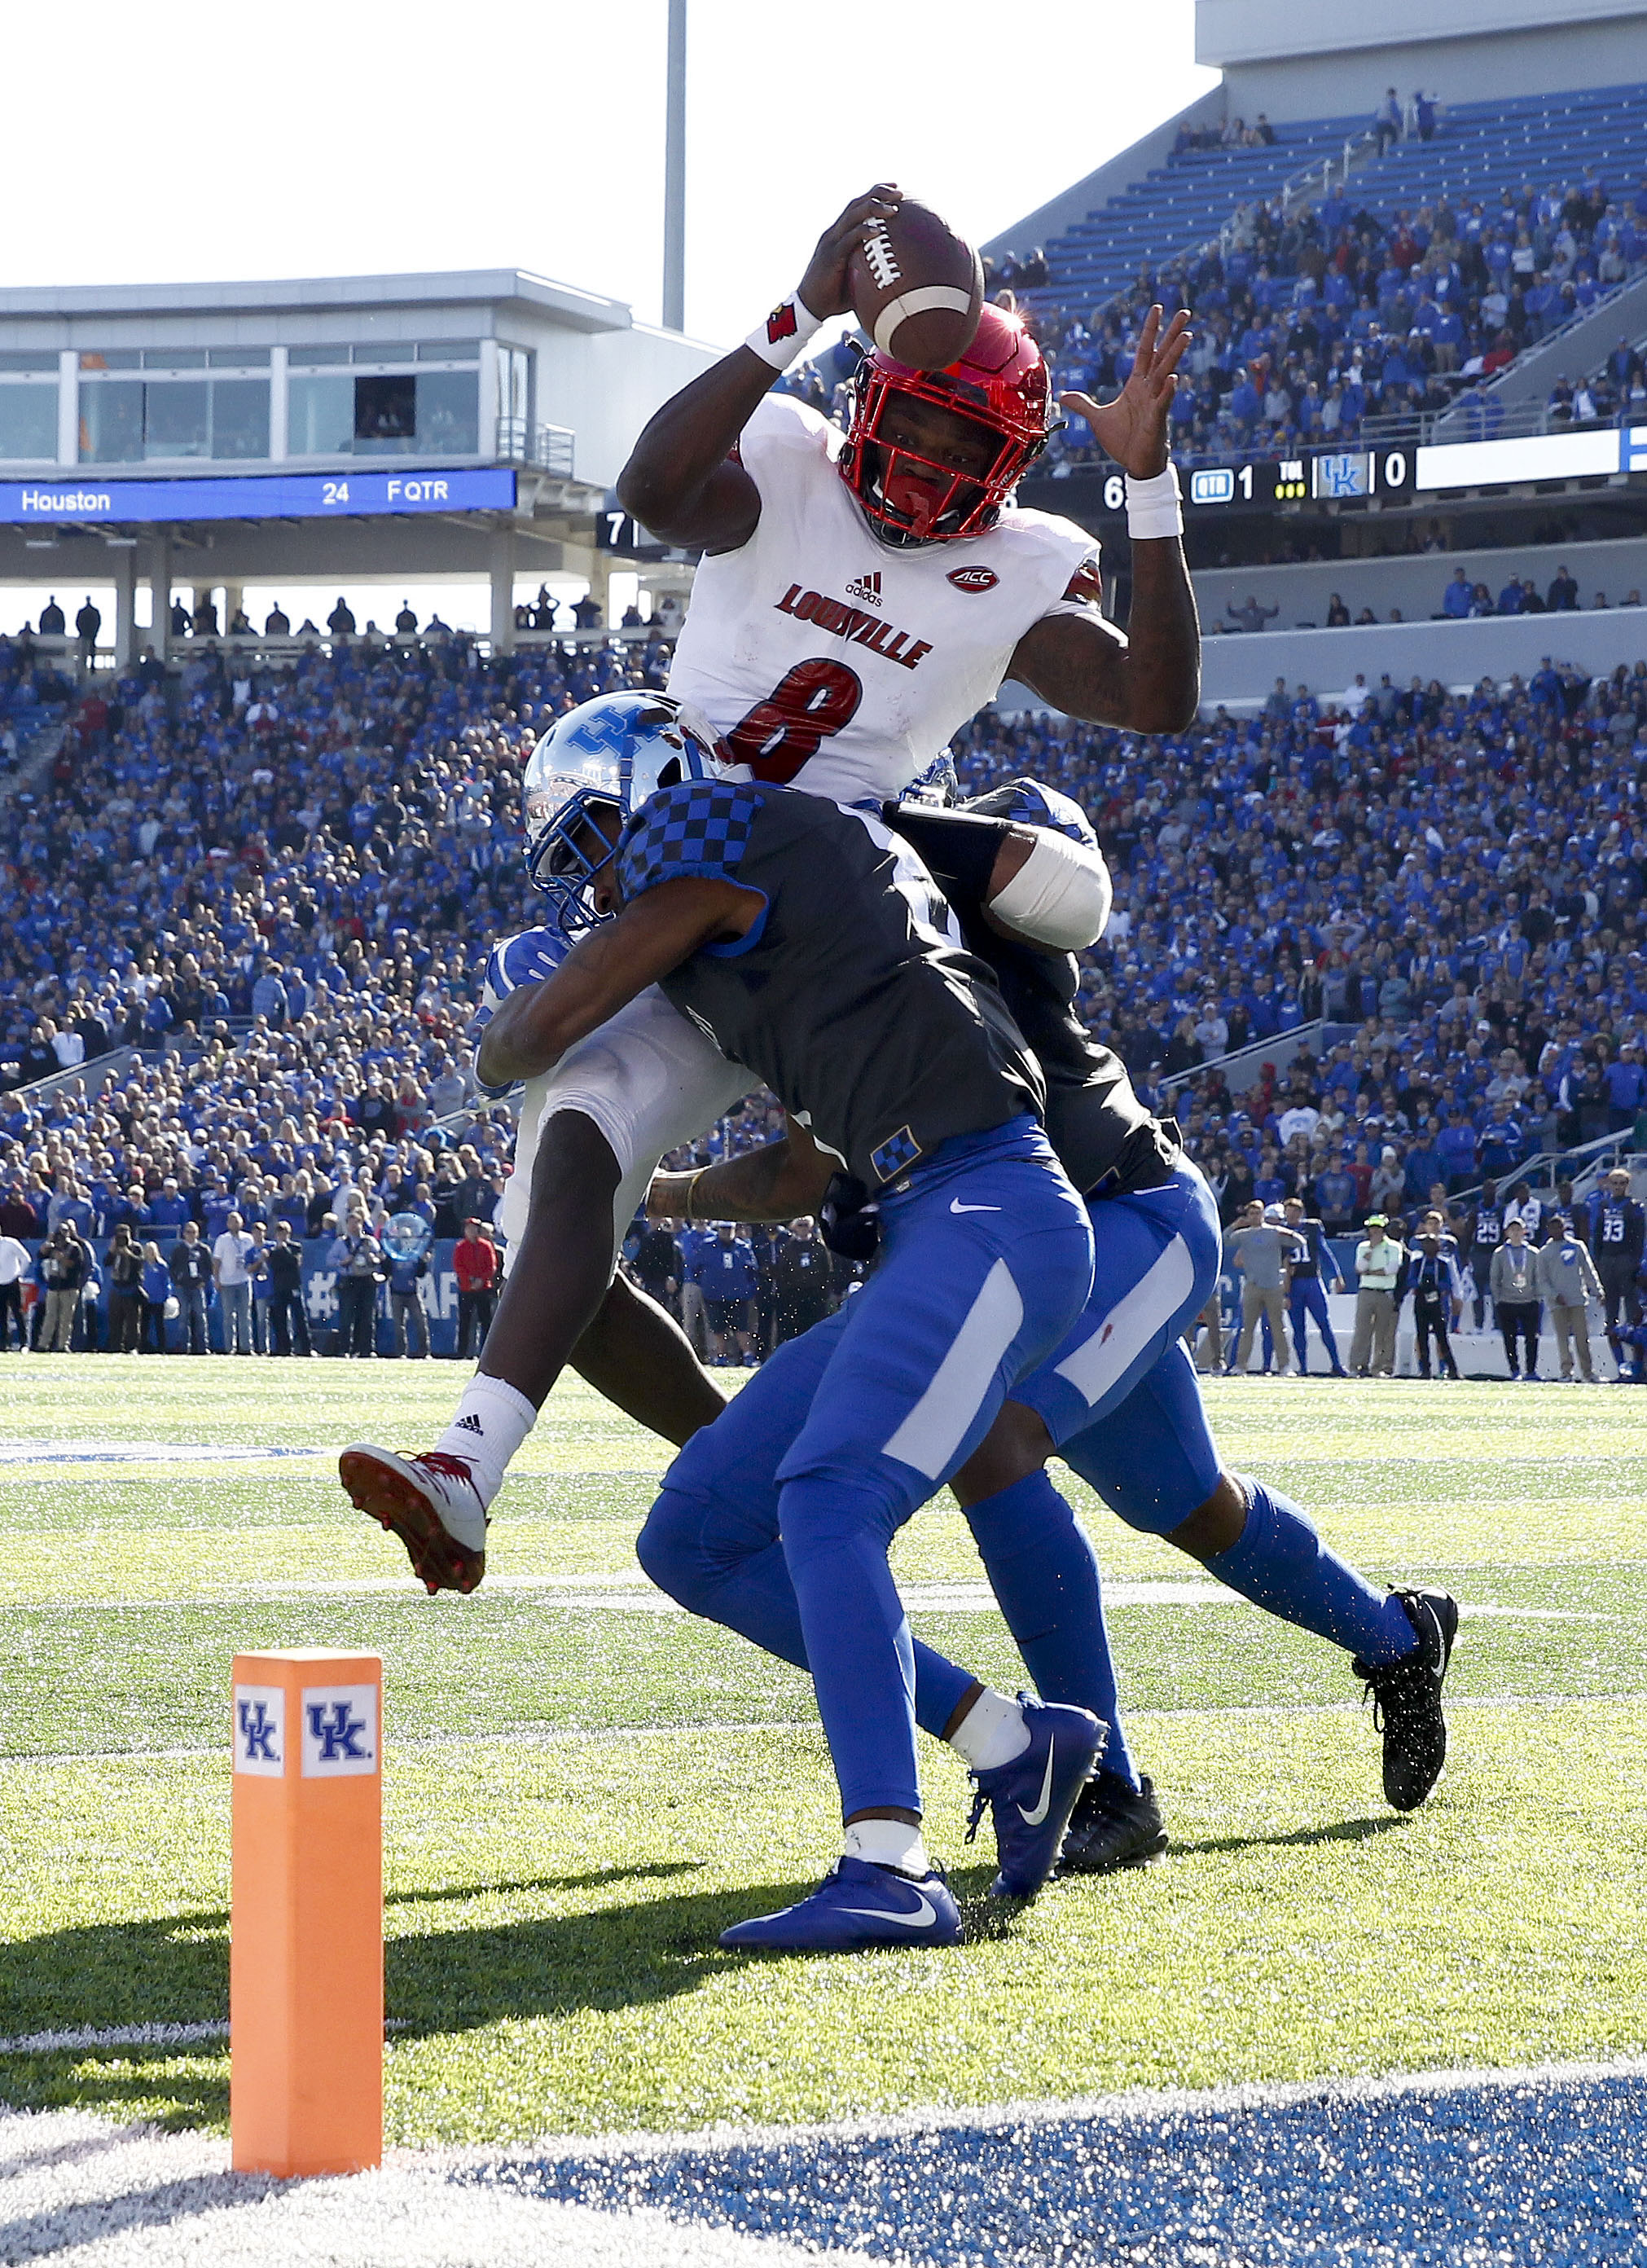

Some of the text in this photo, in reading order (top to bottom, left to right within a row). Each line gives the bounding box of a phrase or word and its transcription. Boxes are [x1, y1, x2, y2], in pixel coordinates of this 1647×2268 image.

[1104, 475, 1124, 509] 6
[1238, 464, 1253, 499] 1
[1320, 451, 1407, 498] UK 0
[21, 490, 111, 512] Houston
[323, 482, 349, 504] 24
[606, 511, 626, 546] 7
[953, 571, 993, 583] ACC
[845, 583, 884, 608] adidas
[774, 582, 934, 670] LOUISVILLE
[726, 657, 863, 785] 8
[1476, 1220, 1501, 1244] 29
[455, 1421, 484, 1437] adidas
[238, 1699, 278, 1761] UK
[306, 1700, 367, 1761] UK
